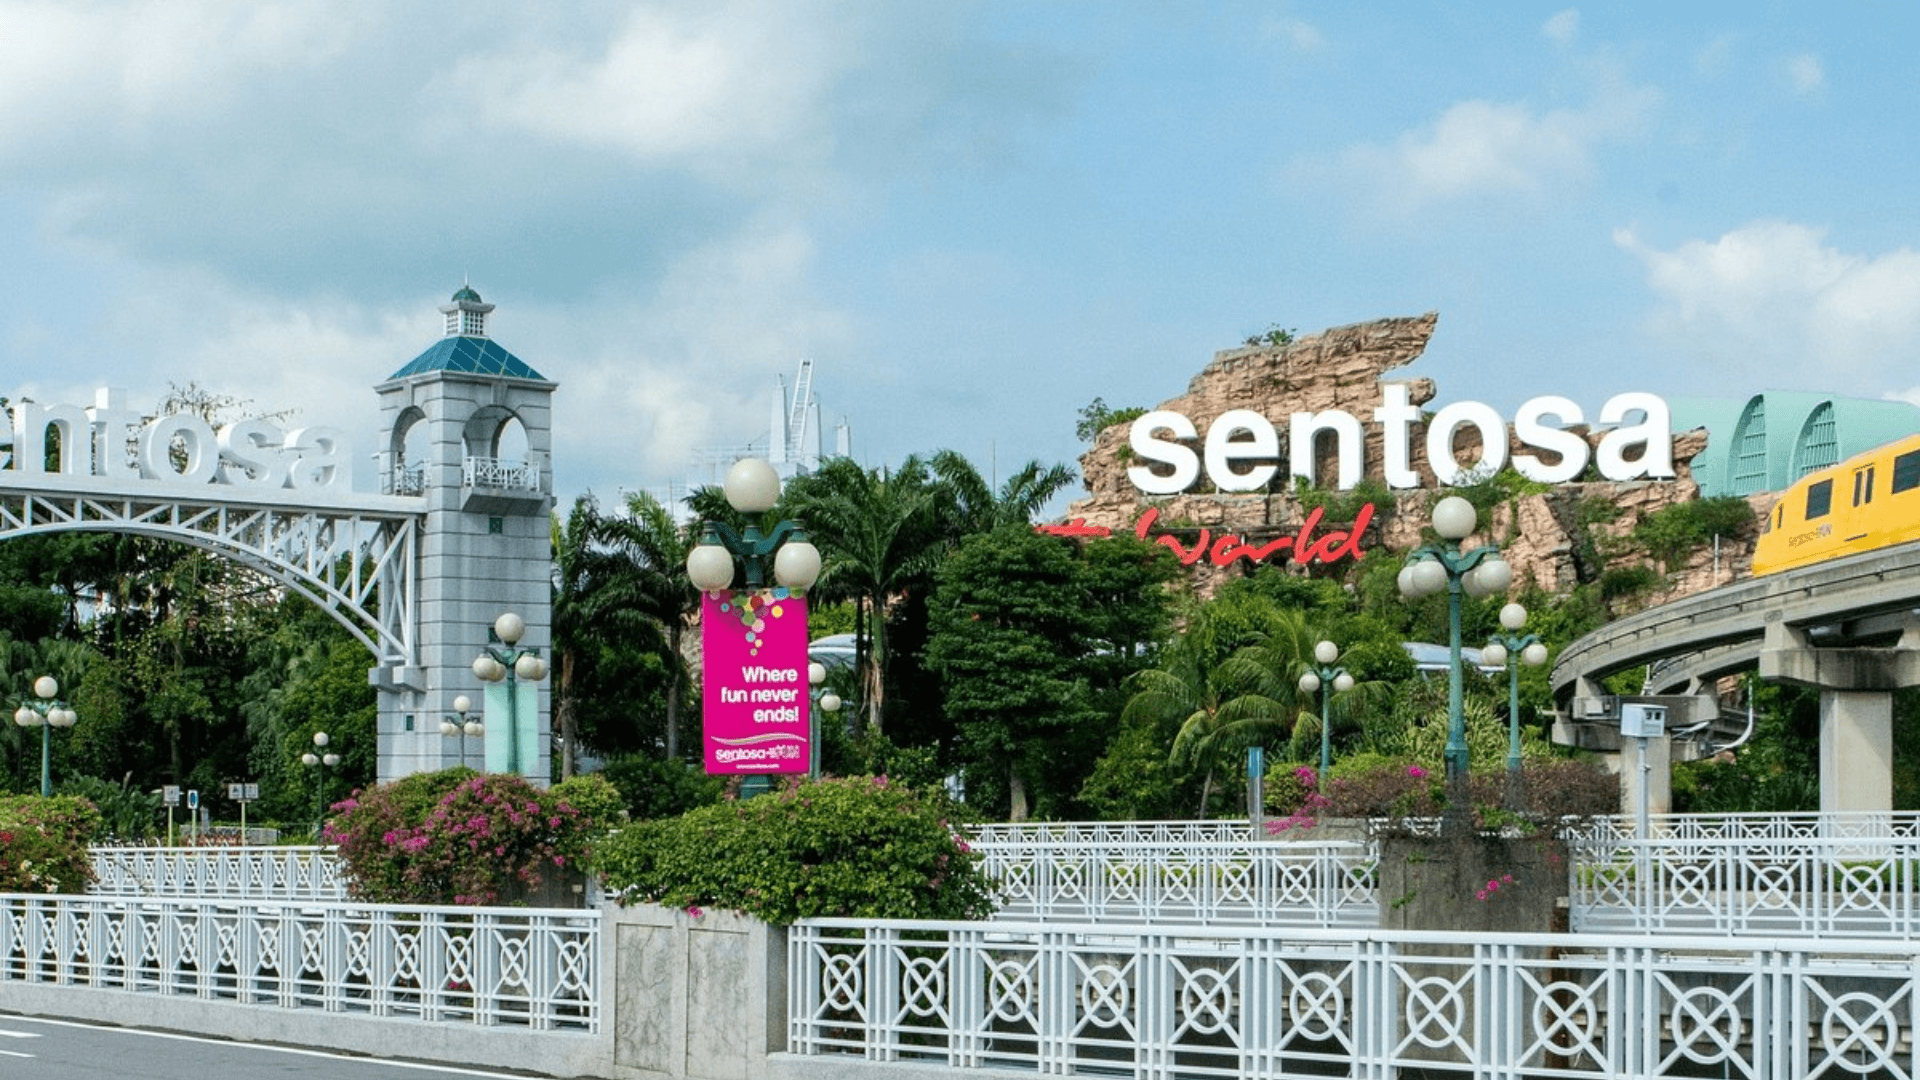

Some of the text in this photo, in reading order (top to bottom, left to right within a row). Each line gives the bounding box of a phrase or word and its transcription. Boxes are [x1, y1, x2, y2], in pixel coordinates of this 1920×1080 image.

[0, 387, 353, 493] ntosa
[1127, 383, 1677, 496] sentosa
[741, 665, 798, 683] Where
[720, 687, 799, 703] fun never
[753, 705, 800, 723] ends!
